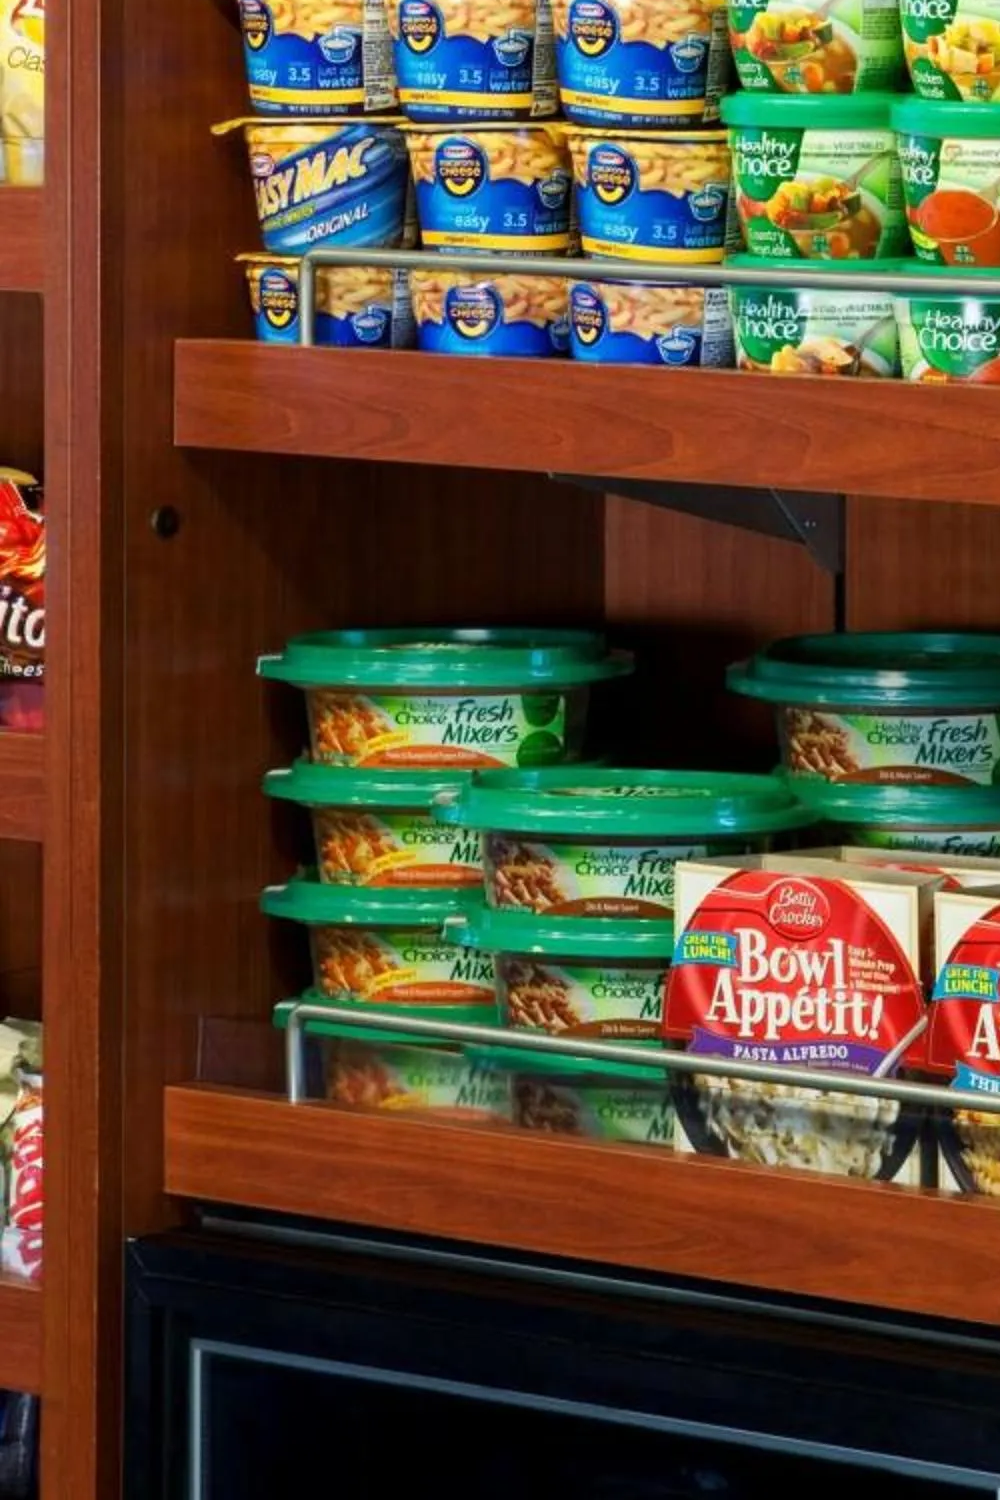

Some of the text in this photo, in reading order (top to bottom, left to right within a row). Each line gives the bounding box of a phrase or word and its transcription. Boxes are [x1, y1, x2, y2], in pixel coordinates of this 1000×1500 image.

[287, 66, 311, 82] 3.5
[318, 76, 361, 88] water
[416, 69, 530, 92] easy 3.5 water
[584, 77, 620, 95] easy
[633, 76, 660, 91] 3.5
[293, 137, 375, 203] MAC
[306, 202, 369, 243] ORIGINAL
[455, 214, 490, 233] easy
[503, 213, 528, 228] 3.5
[603, 225, 639, 243] easy
[652, 224, 678, 240] 3.5
[919, 326, 998, 352] Choice
[395, 710, 446, 725] Choice
[455, 699, 514, 724] Fresh
[441, 723, 518, 745] Mixers
[867, 730, 920, 745] Choice
[928, 718, 988, 744] Fresh
[915, 741, 993, 765] Mixers
[402, 830, 454, 845] Choice
[942, 835, 1000, 857] Fresh
[575, 860, 629, 876] Choice
[780, 886, 817, 912] Betty
[769, 902, 824, 927] Crocker
[684, 934, 729, 947] GREAT FOR
[402, 948, 456, 962] Choice
[683, 945, 731, 960] LUNCH!
[735, 927, 848, 989] Bowl
[972, 969, 991, 980] FOR
[591, 982, 646, 998] Choice
[943, 979, 993, 997] LUNCH!
[704, 966, 884, 1041] Appétit!
[733, 1043, 849, 1061] PASTA ALFREDO
